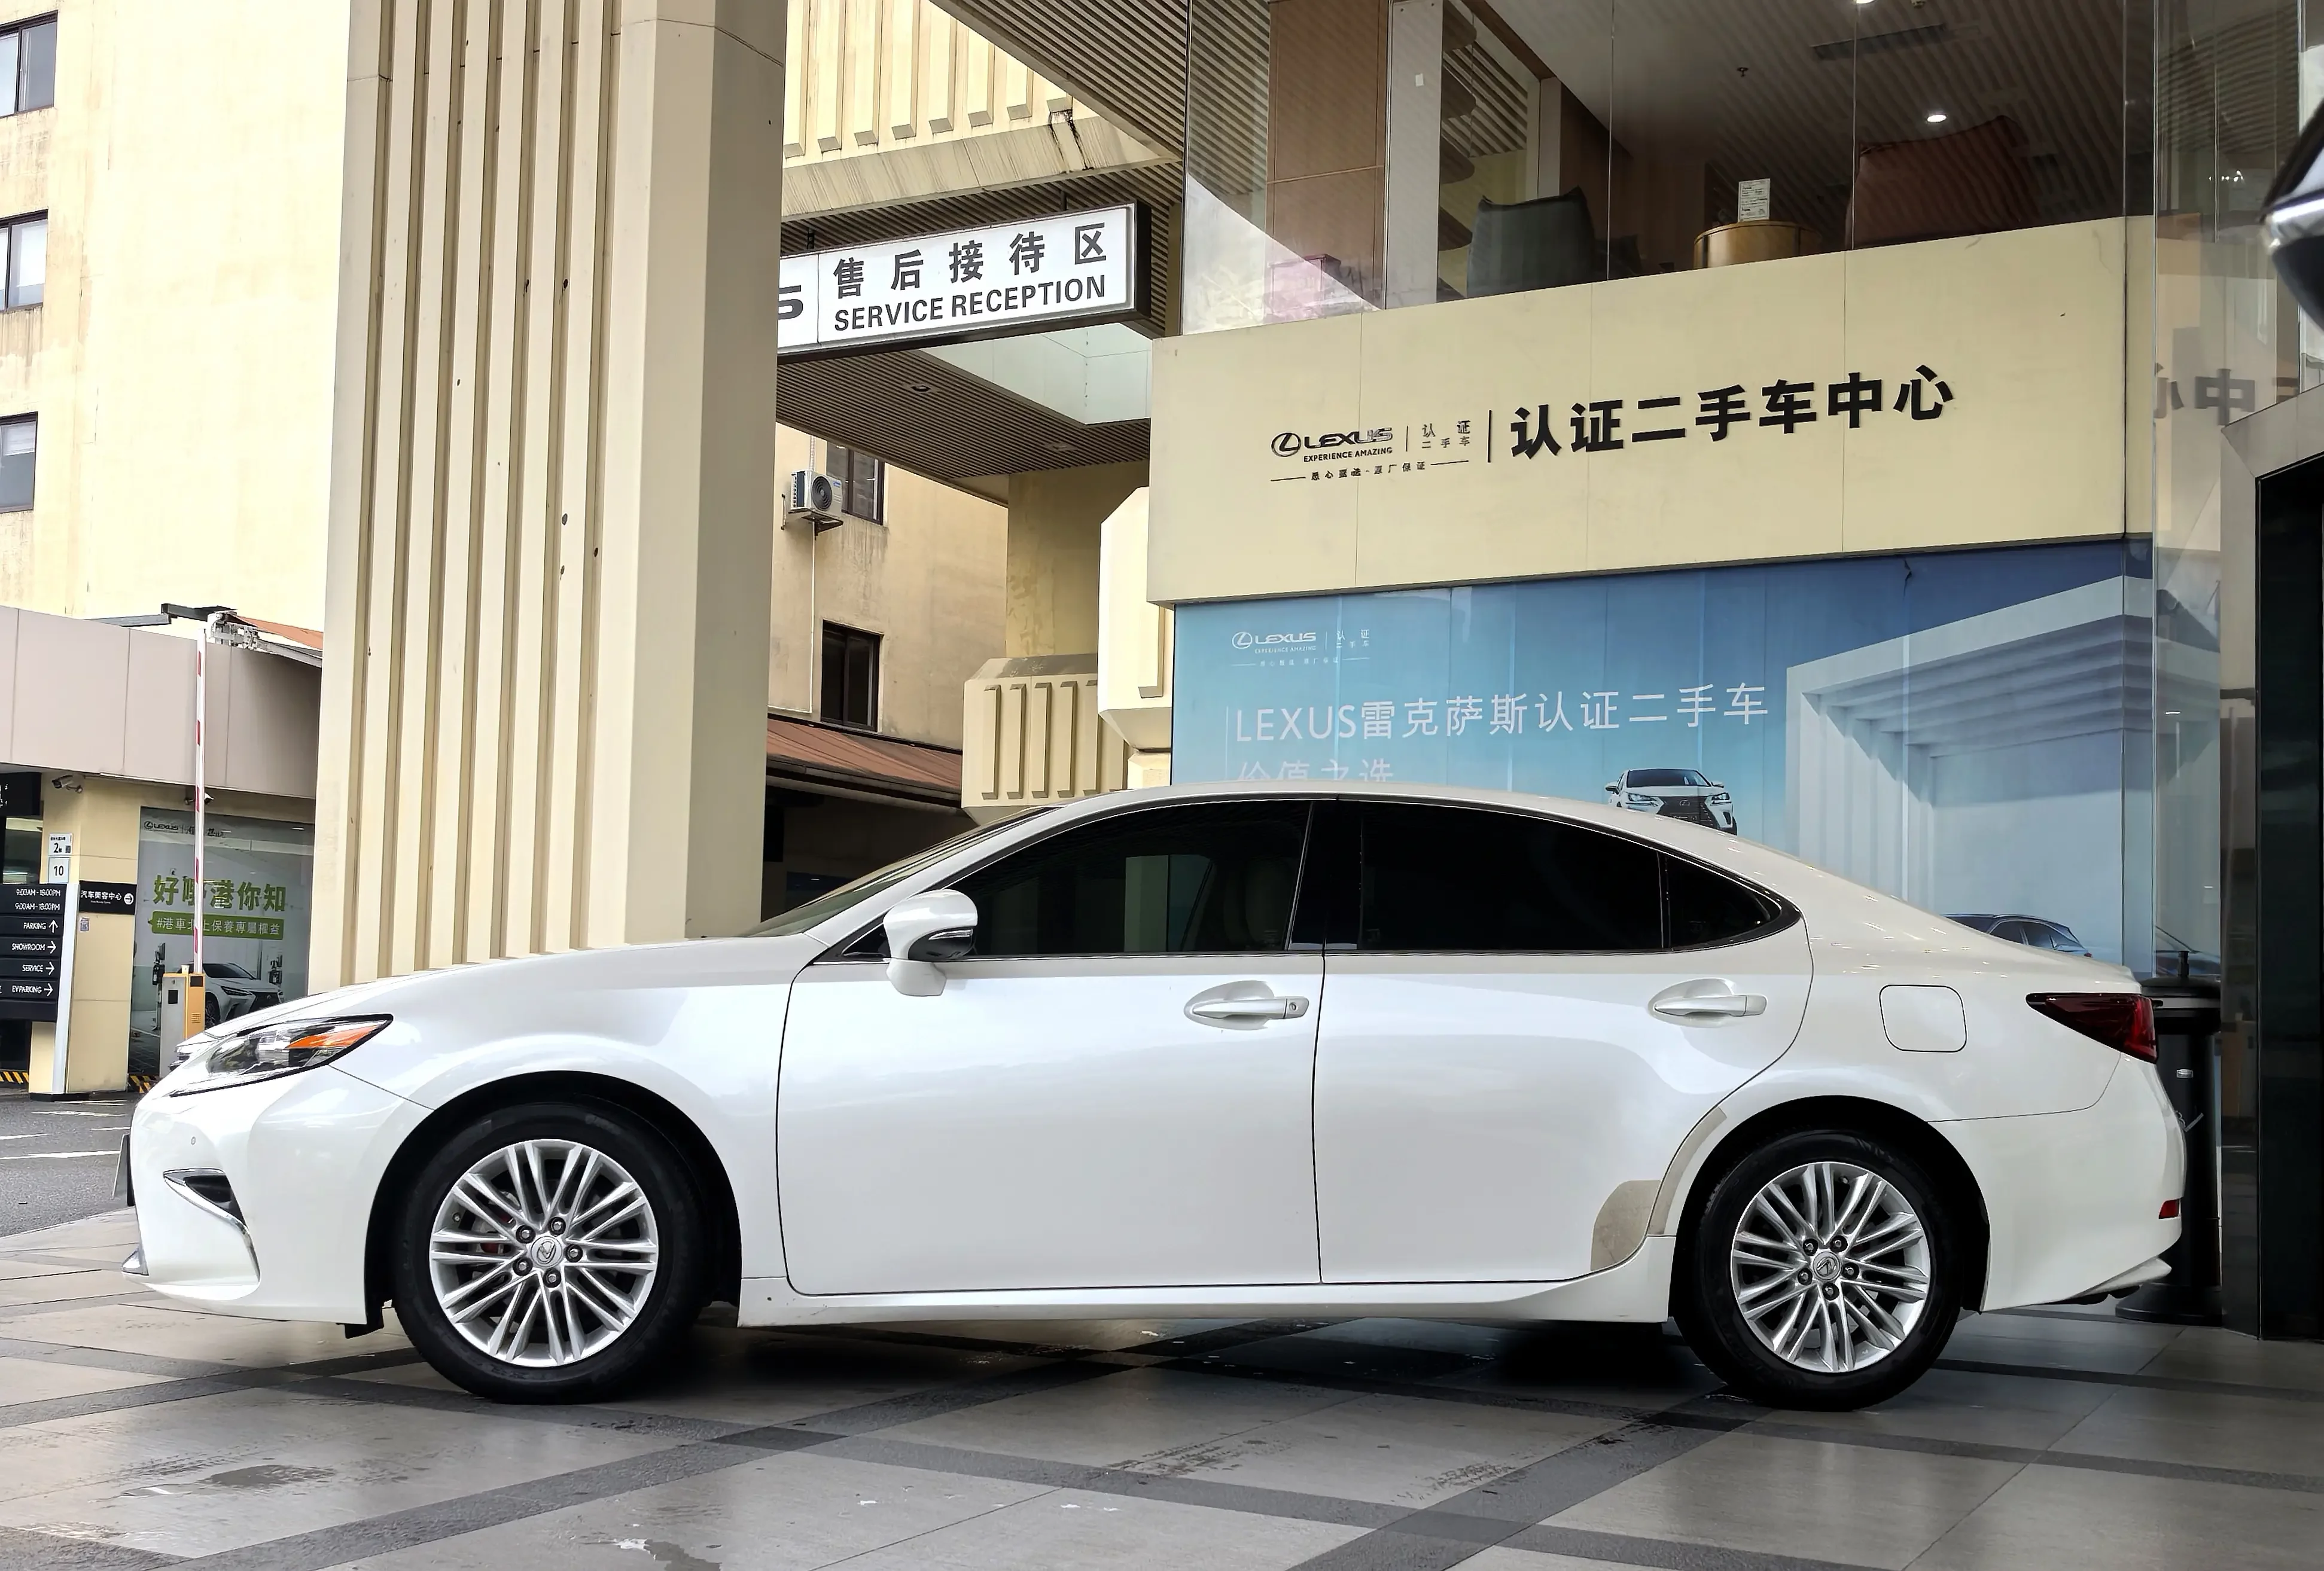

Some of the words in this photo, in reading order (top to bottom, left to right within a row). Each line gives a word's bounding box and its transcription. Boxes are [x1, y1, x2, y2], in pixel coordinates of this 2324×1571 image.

[833, 222, 1107, 300] 售后接待区
[834, 298, 943, 331] SERVICE
[952, 275, 1105, 318] RECEPTION
[1510, 364, 1954, 459] 认证二手车中心
[1304, 427, 1393, 449] LEXUS
[1303, 451, 1353, 462] EXPERIENCE
[1354, 447, 1393, 457] AMAZING
[1255, 632, 1317, 644] LEXUS
[54, 865, 64, 876] 10
[80, 890, 122, 901] 汽车美容中心
[11, 942, 45, 951] SHOWROOM
[19, 986, 42, 994] PARKING
